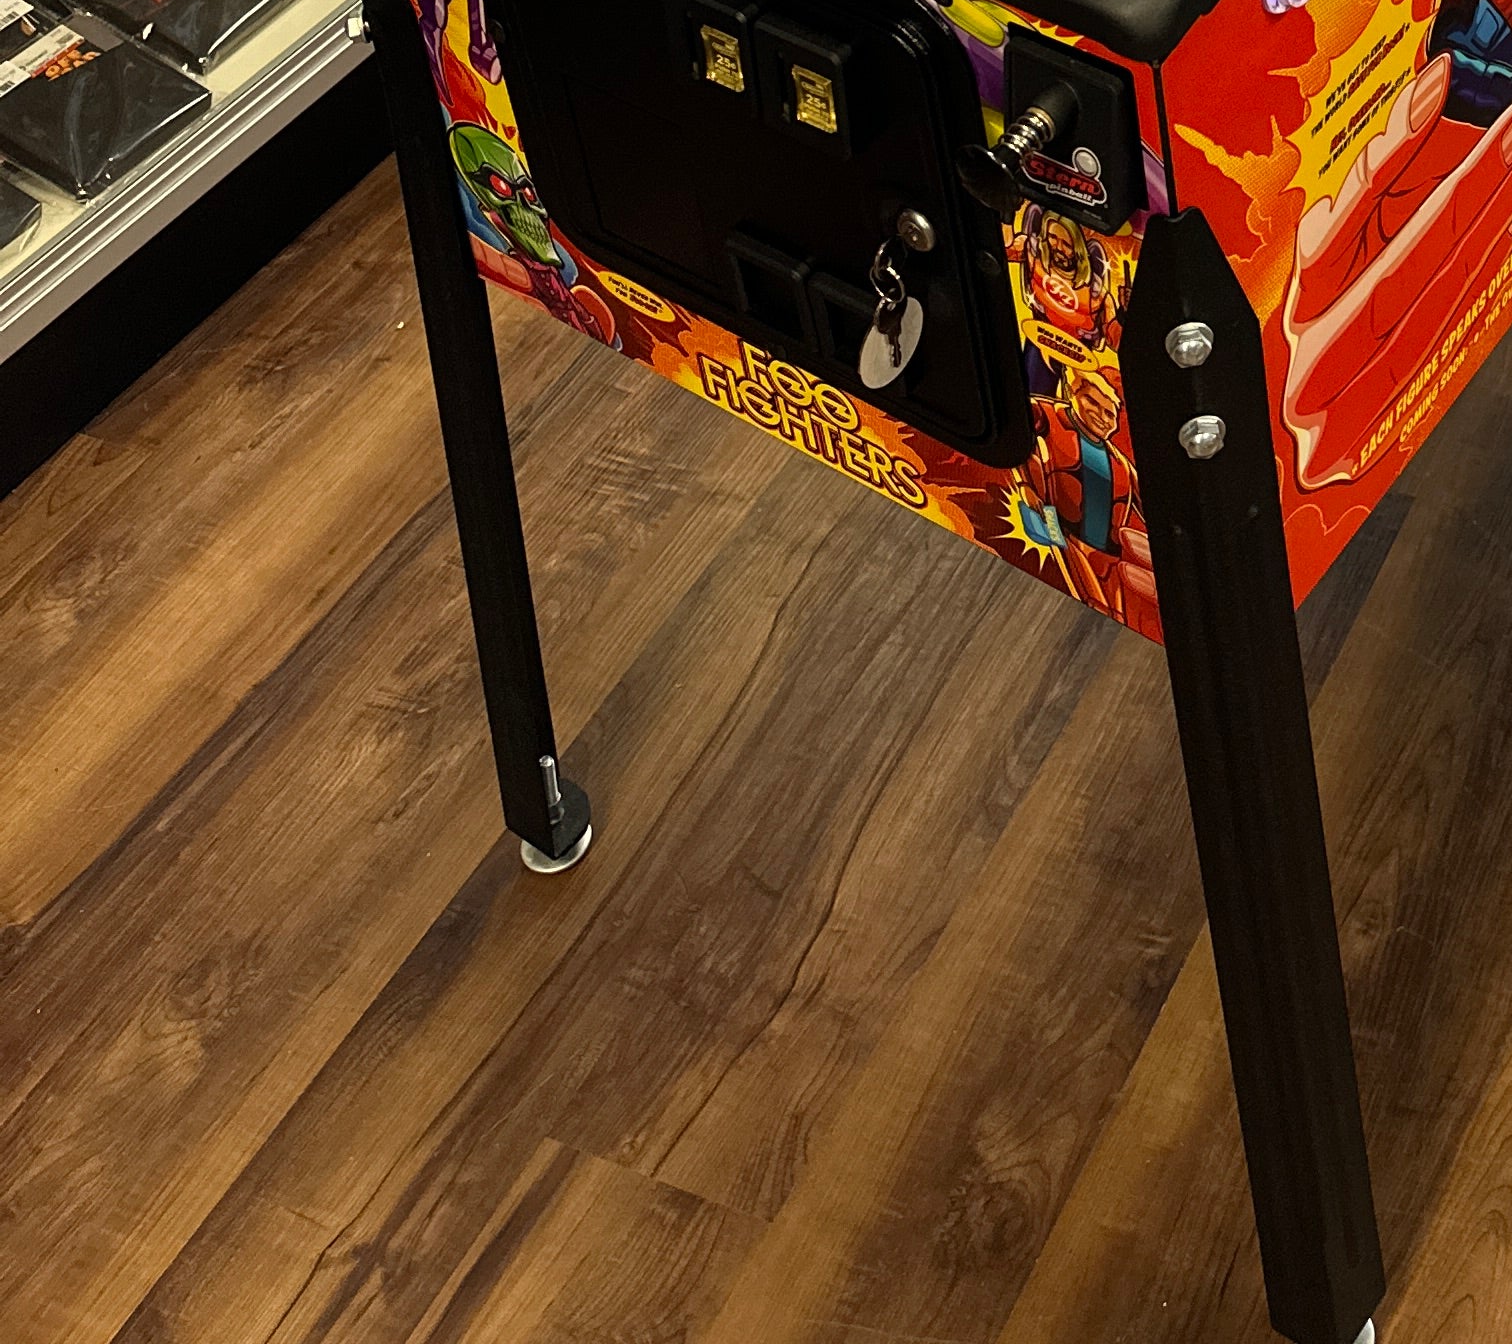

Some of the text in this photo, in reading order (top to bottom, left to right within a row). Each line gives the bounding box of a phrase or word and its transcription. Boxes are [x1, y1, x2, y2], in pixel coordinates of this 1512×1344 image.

[1346, 62, 1361, 85] GOT
[1361, 54, 1371, 69] TO
[1311, 92, 1348, 139] THE WORLD
[1318, 158, 1332, 180] YOU
[1332, 134, 1352, 163] WANT
[1371, 106, 1380, 119] OF
[1030, 159, 1095, 193] Stern
[1047, 183, 1093, 202] pinball
[1037, 325, 1055, 339] WHO
[1055, 334, 1083, 353] WANTS
[741, 341, 860, 431] FOO
[1360, 415, 1394, 468] EACH
[1395, 351, 1440, 422] FIGURE
[1440, 290, 1487, 362] SPEAKS
[1399, 385, 1439, 443] COMING
[1484, 300, 1501, 330] THE
[700, 354, 928, 506] FIGHTERS
